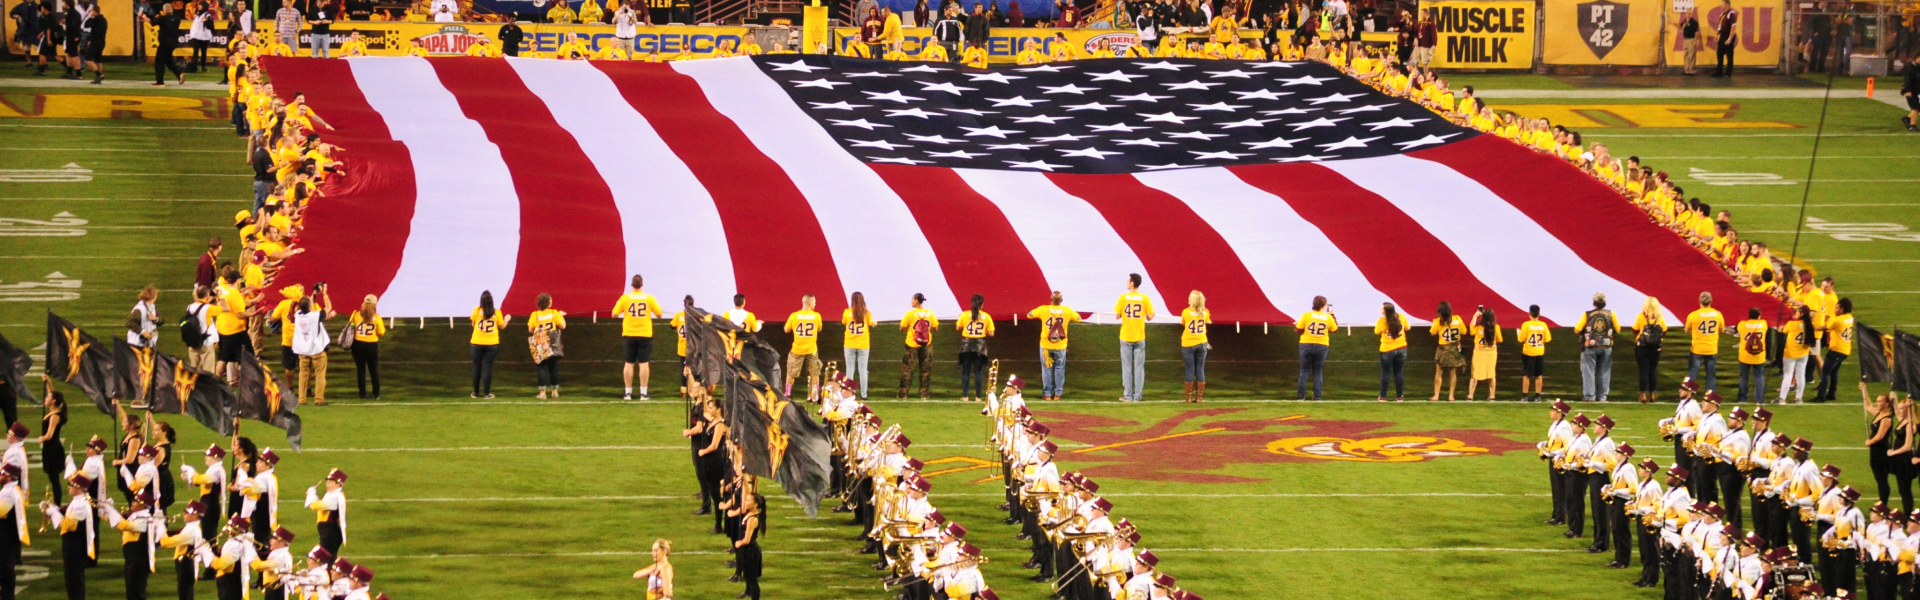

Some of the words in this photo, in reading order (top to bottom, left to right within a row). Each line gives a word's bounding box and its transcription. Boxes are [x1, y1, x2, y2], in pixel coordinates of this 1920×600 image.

[1429, 6, 1525, 33] MUSCLE
[1590, 5, 1614, 23] PT
[1674, 6, 1774, 53] ASU
[421, 34, 450, 52] APA
[634, 33, 742, 54] GEICO
[1589, 29, 1614, 47] 42
[1446, 35, 1509, 63] MILK
[628, 302, 647, 317] 42
[1124, 303, 1142, 318] 42
[356, 321, 376, 336] 42
[477, 319, 495, 334] 42
[796, 322, 815, 337] 42
[848, 320, 865, 335] 42
[966, 320, 985, 336] 42
[1188, 319, 1205, 334] 42
[1307, 321, 1327, 336] 42
[1698, 320, 1717, 334] 42
[1441, 327, 1460, 342] 42
[1528, 333, 1543, 347] 42
